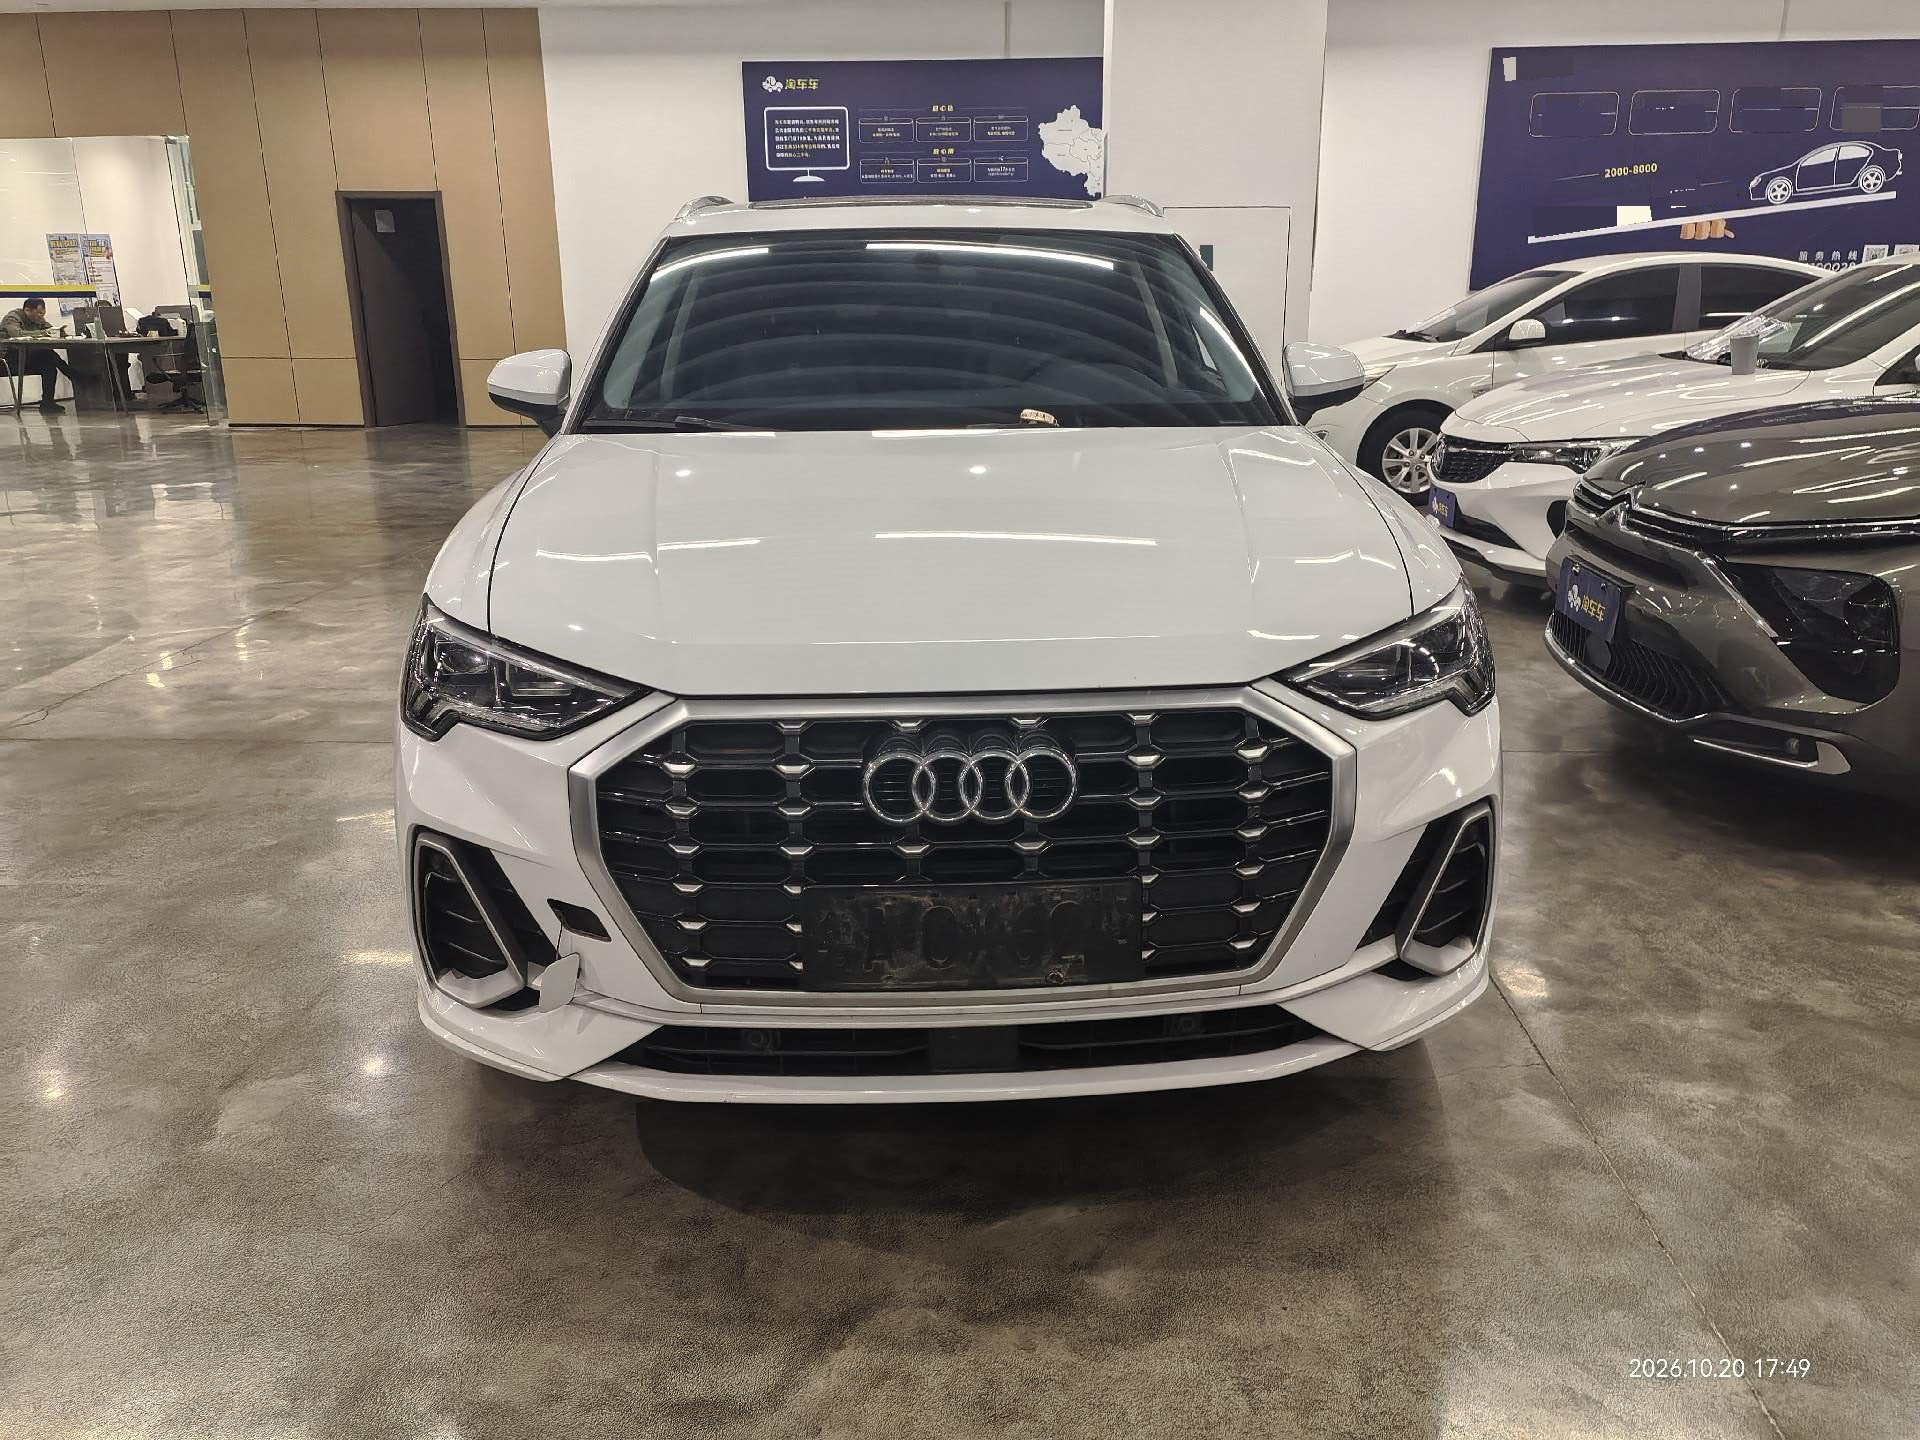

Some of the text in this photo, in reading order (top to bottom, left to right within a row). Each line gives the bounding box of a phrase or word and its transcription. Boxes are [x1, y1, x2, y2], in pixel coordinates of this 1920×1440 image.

[784, 79, 819, 90] 淘车车
[1604, 162, 1658, 179] 2000-8000
[1581, 594, 1606, 622] 淘车车
